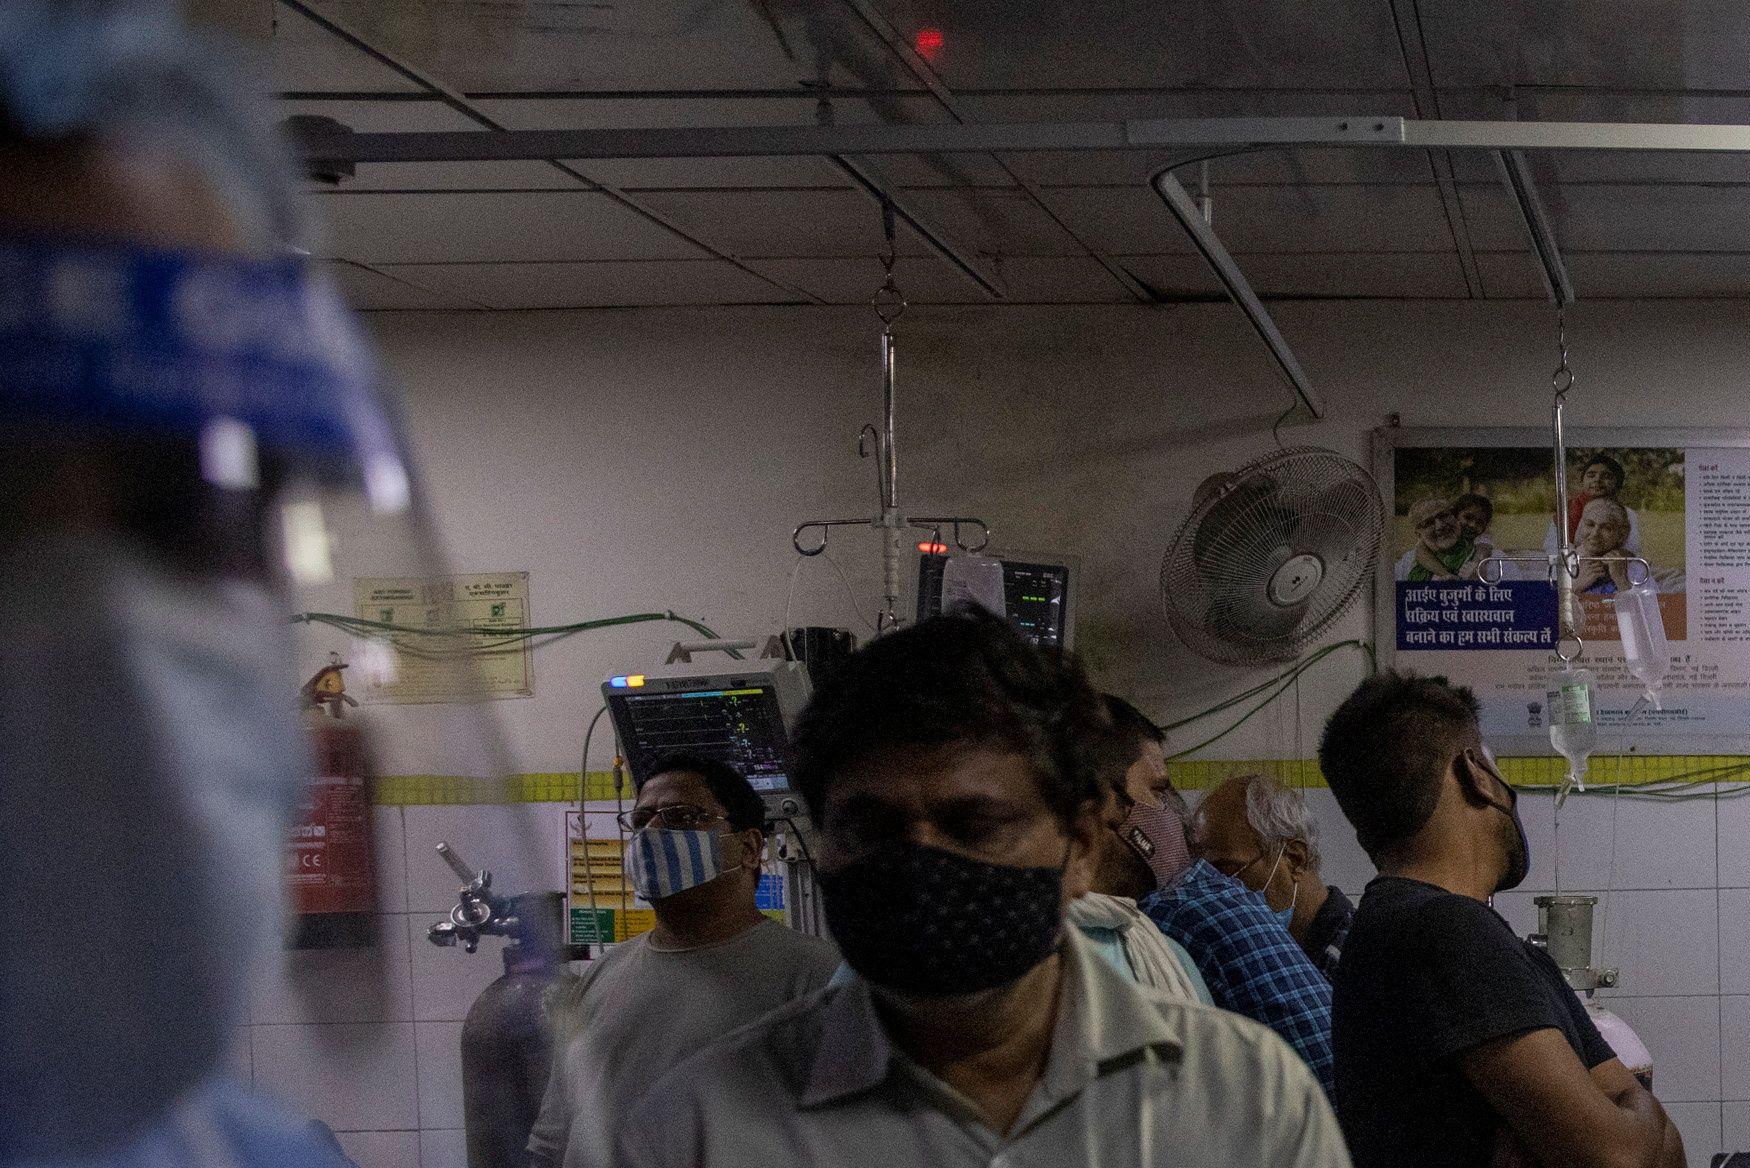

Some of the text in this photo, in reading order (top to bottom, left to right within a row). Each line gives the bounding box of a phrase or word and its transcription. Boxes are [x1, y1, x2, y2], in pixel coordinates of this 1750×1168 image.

[1475, 586, 1486, 602] के
[1488, 586, 1512, 602] लिए
[1406, 628, 1436, 644] बनाने
[1439, 631, 1455, 644] का
[1458, 631, 1475, 646] हम
[1477, 627, 1500, 643] सभी
[1504, 628, 1538, 643] संकल्प
